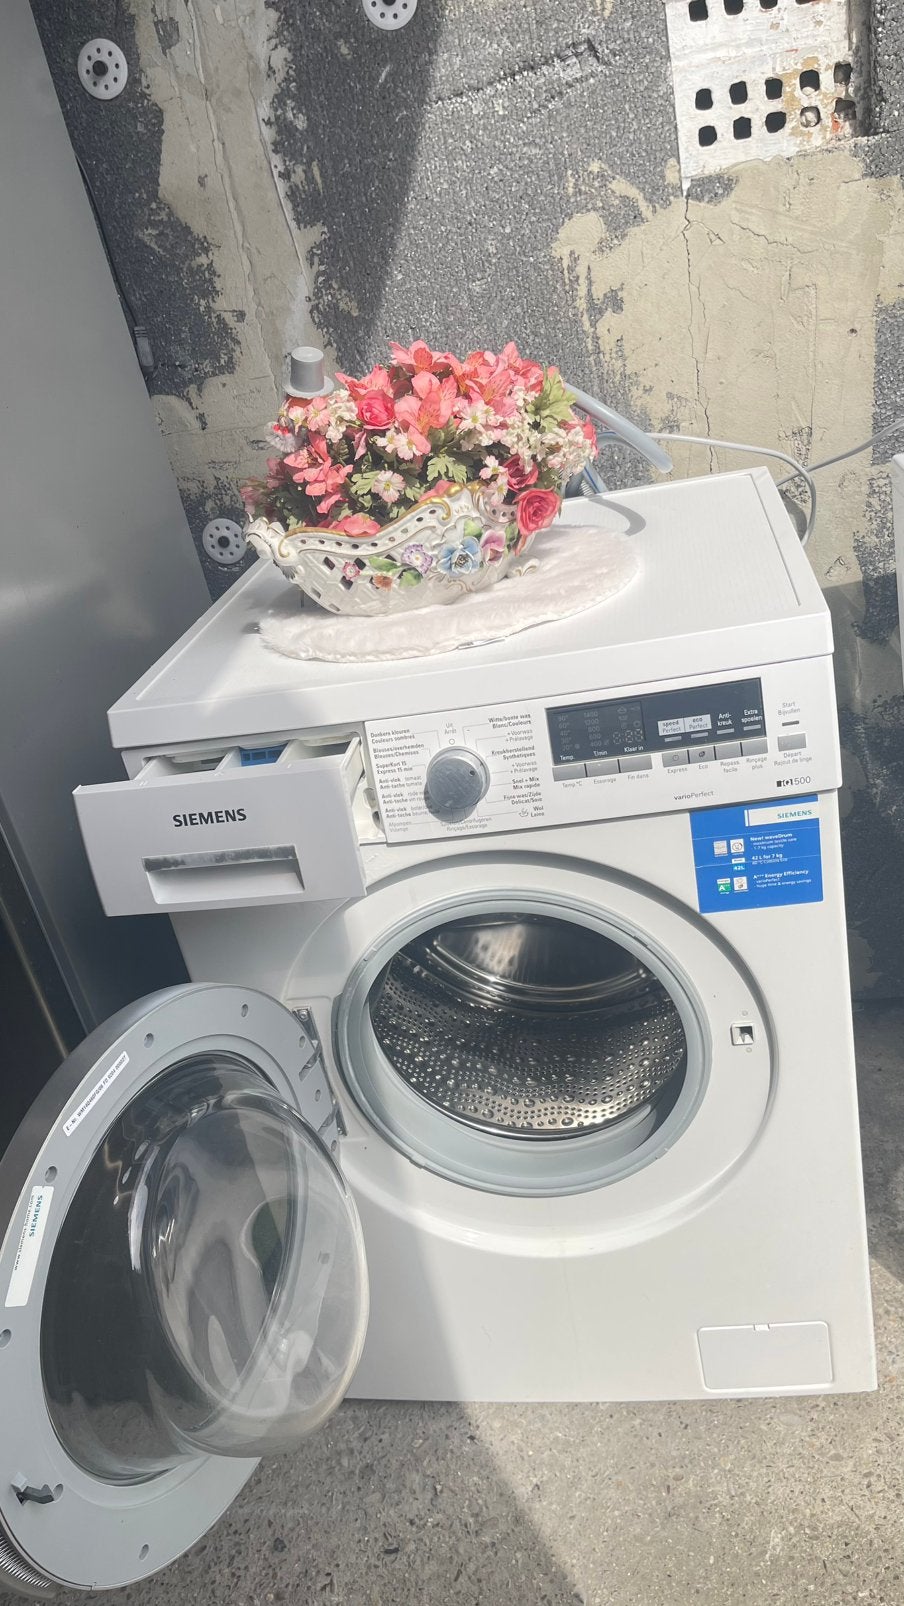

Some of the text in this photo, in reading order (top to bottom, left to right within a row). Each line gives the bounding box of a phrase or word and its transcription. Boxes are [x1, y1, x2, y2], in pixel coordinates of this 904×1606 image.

[492, 720, 531, 728] Blanc/Couleurs
[674, 790, 714, 800] varioPerfect
[172, 808, 247, 827] SIEMENS
[777, 810, 812, 819] SIEMENS
[29, 1195, 43, 1237] SIEMENS
